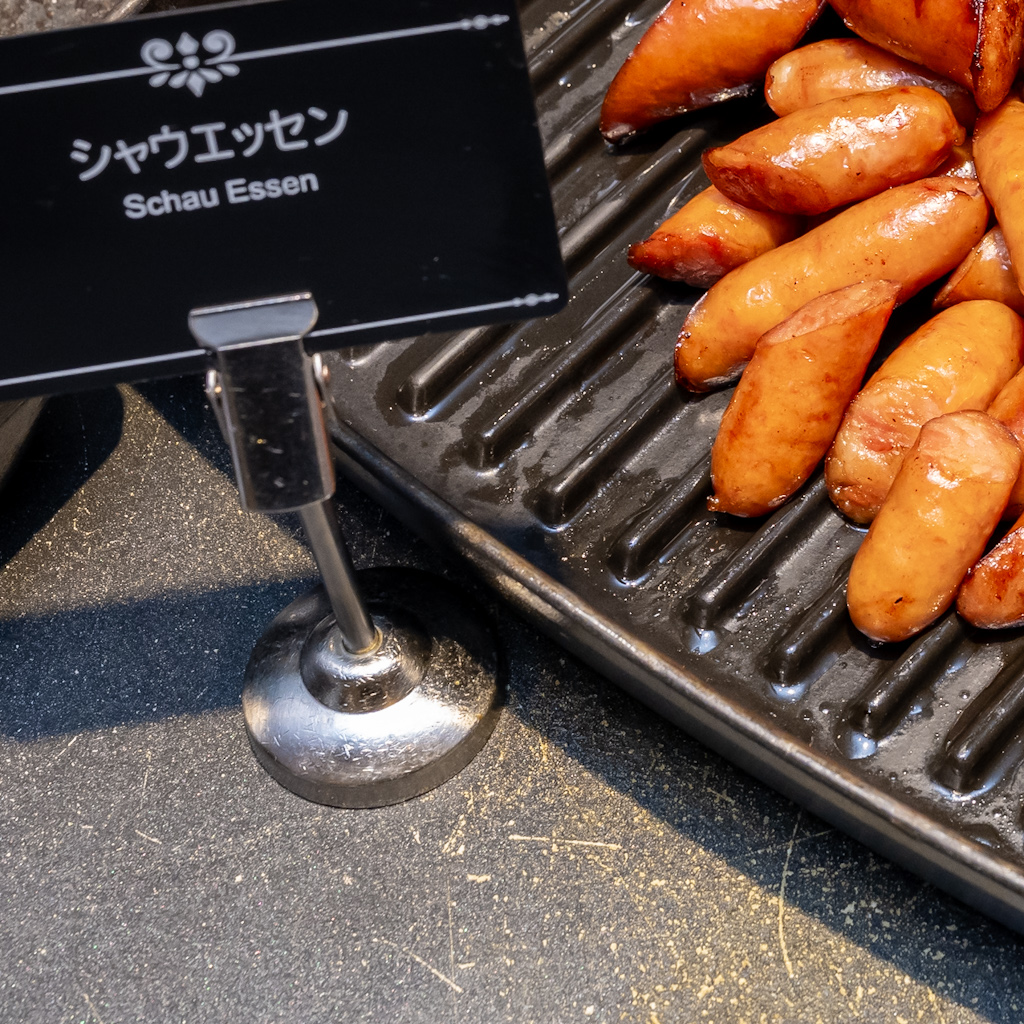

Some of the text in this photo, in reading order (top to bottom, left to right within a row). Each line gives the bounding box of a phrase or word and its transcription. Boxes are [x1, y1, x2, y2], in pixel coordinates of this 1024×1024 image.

[70, 107, 349, 182] シャウエッセン
[122, 173, 320, 219] Schau Essen
